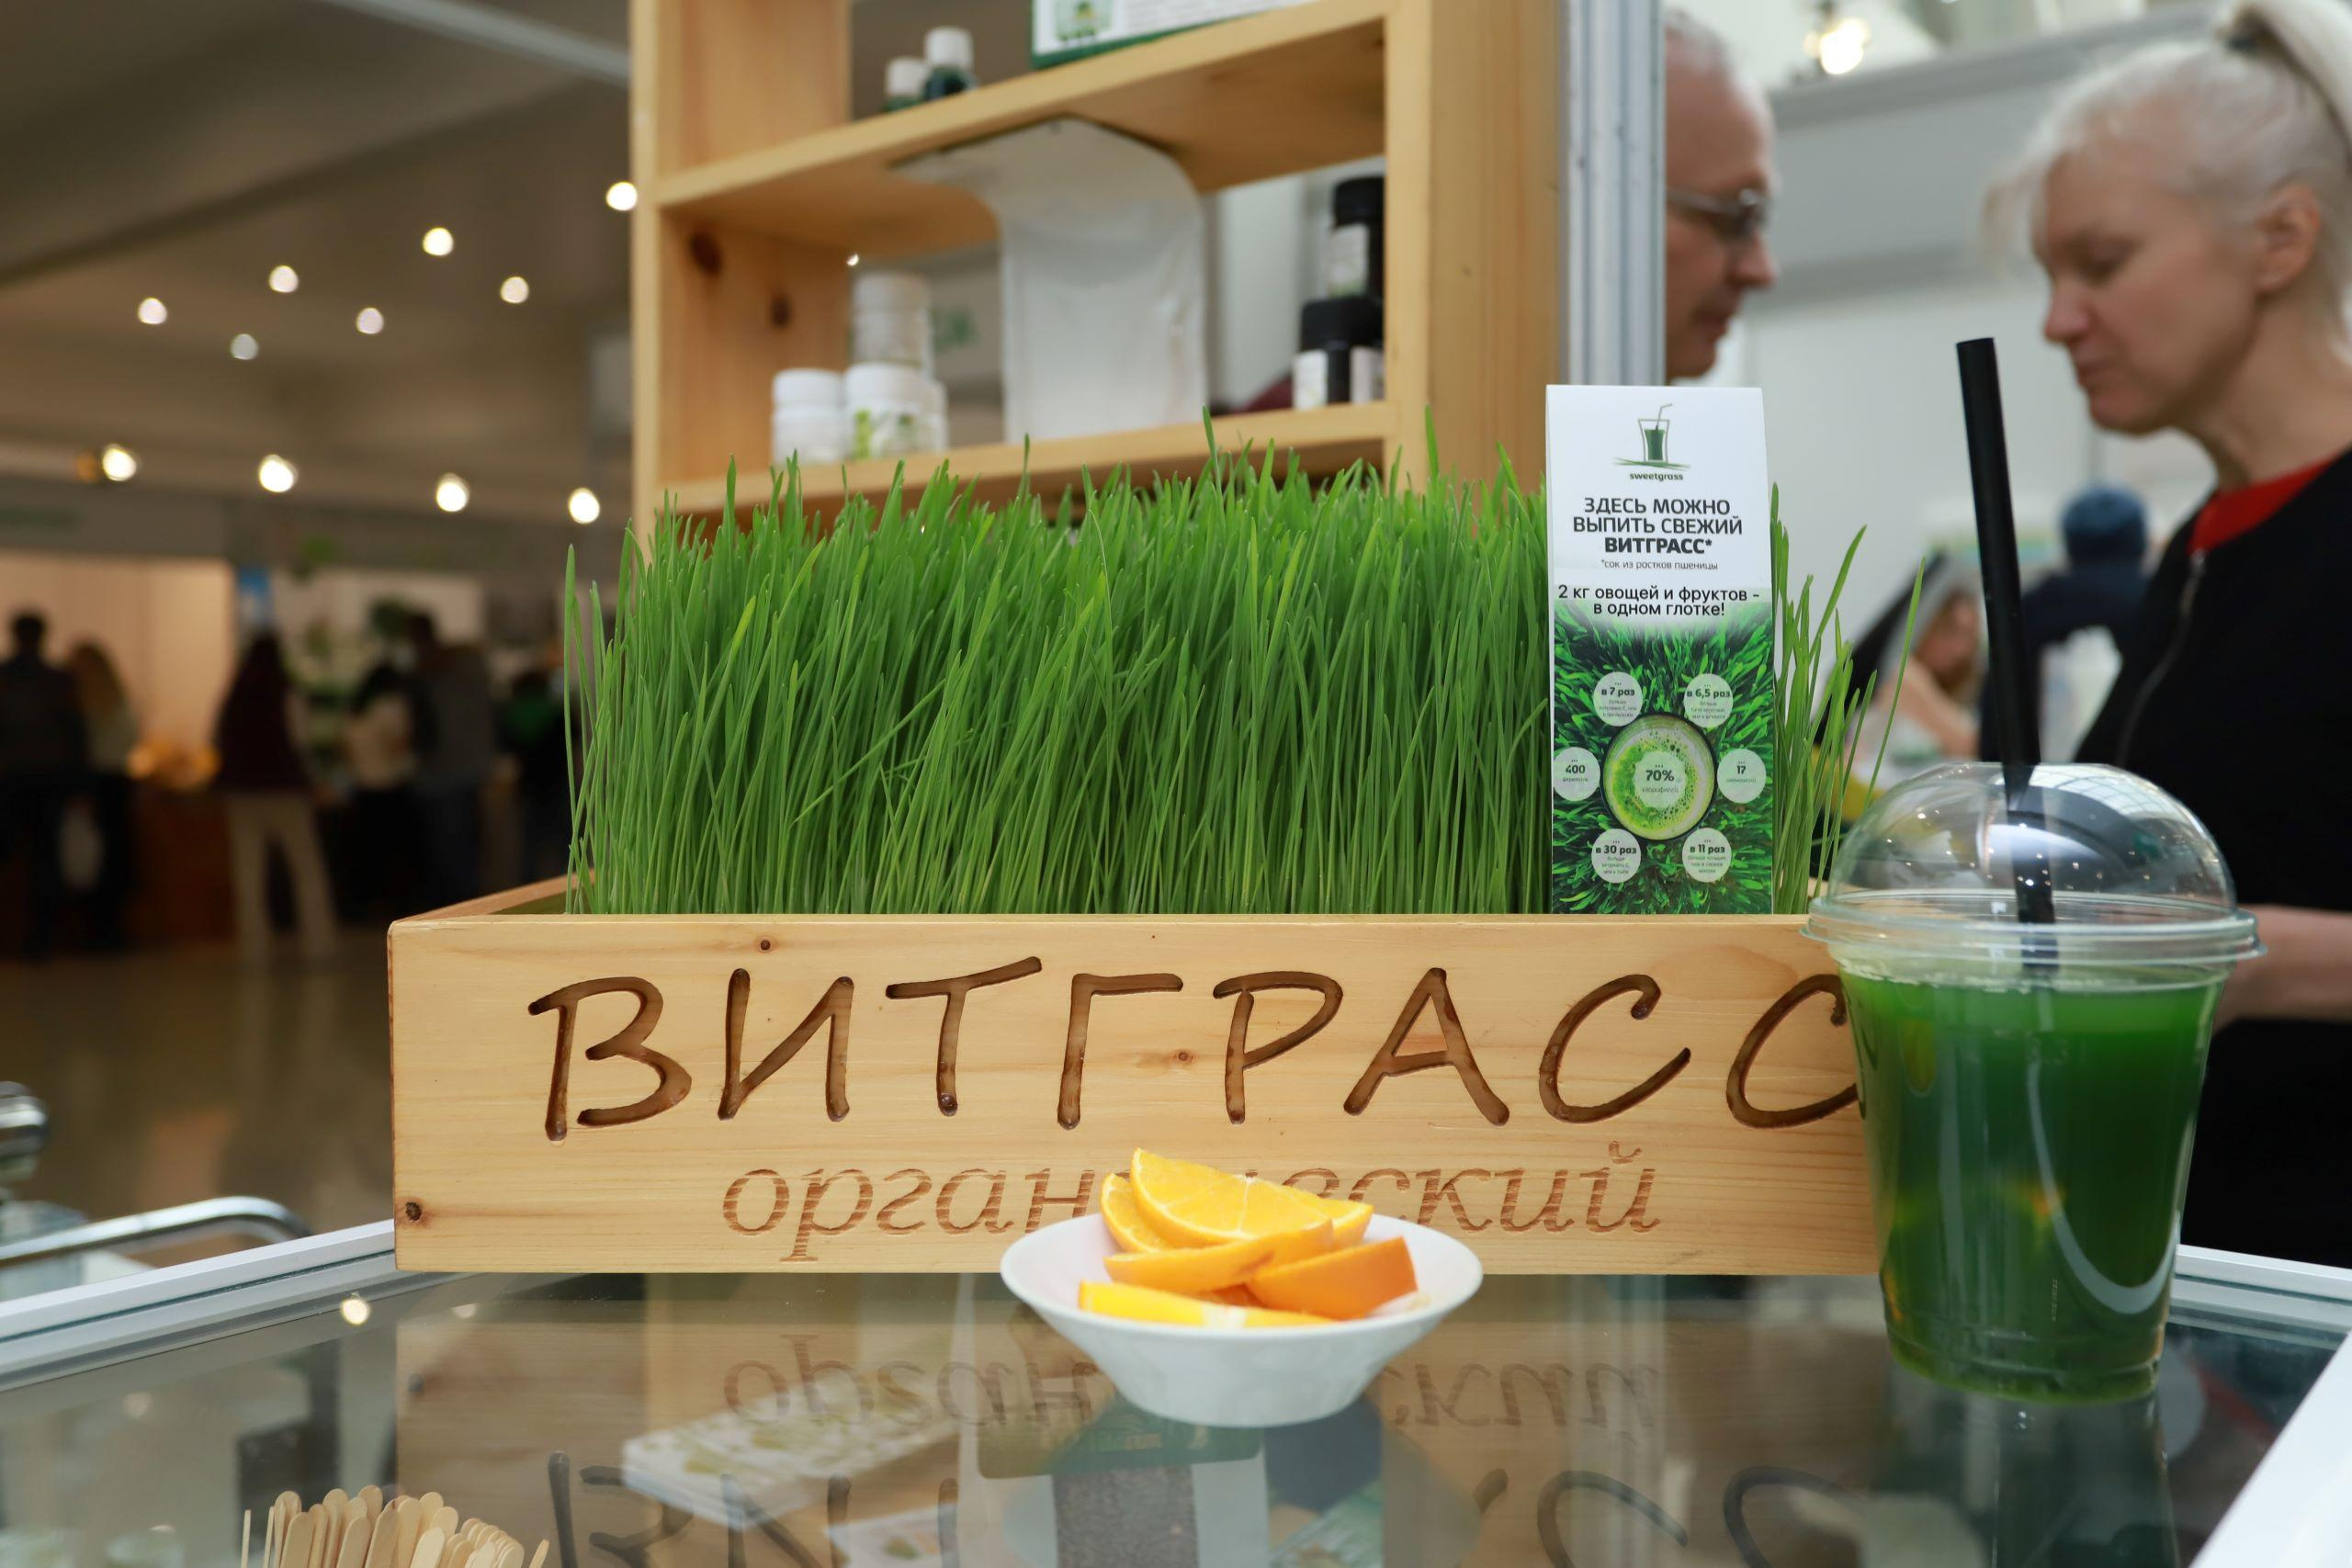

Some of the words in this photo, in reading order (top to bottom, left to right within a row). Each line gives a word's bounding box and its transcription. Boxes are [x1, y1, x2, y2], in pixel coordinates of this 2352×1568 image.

[1629, 472, 1684, 482] sweetgrass
[1584, 497, 1647, 515] ЗДЕСЬ
[1653, 498, 1731, 516] МОЖНО
[1573, 516, 1656, 534] ВЫПИТЬ
[1661, 515, 1743, 536] СВЕЖИЙ
[1623, 561, 1634, 570] из
[1635, 561, 1672, 570] ростков
[1674, 562, 1718, 570] пшеницы
[1558, 584, 1568, 599] 2
[1573, 588, 1590, 599] кг
[1594, 584, 1659, 603] овощей
[1664, 590, 1674, 601] и
[1678, 586, 1747, 605] фруктов
[1593, 604, 1603, 615] в
[1607, 603, 1661, 617] одном
[1666, 601, 1725, 616] глотке!
[1609, 687, 1616, 696] 7
[1617, 690, 1635, 698] раз
[1694, 689, 1711, 699] 6,5
[1713, 692, 1731, 700] раз
[1565, 765, 1586, 774] 400
[1736, 765, 1747, 775] 17
[1645, 769, 1675, 782] 70%
[1603, 845, 1618, 854] 30
[1619, 848, 1637, 856] раз
[1697, 844, 1706, 853] 11
[1707, 847, 1725, 855] раз
[528, 955, 1859, 1141] ВИТГРАСС
[724, 1145, 1660, 1262] органский
